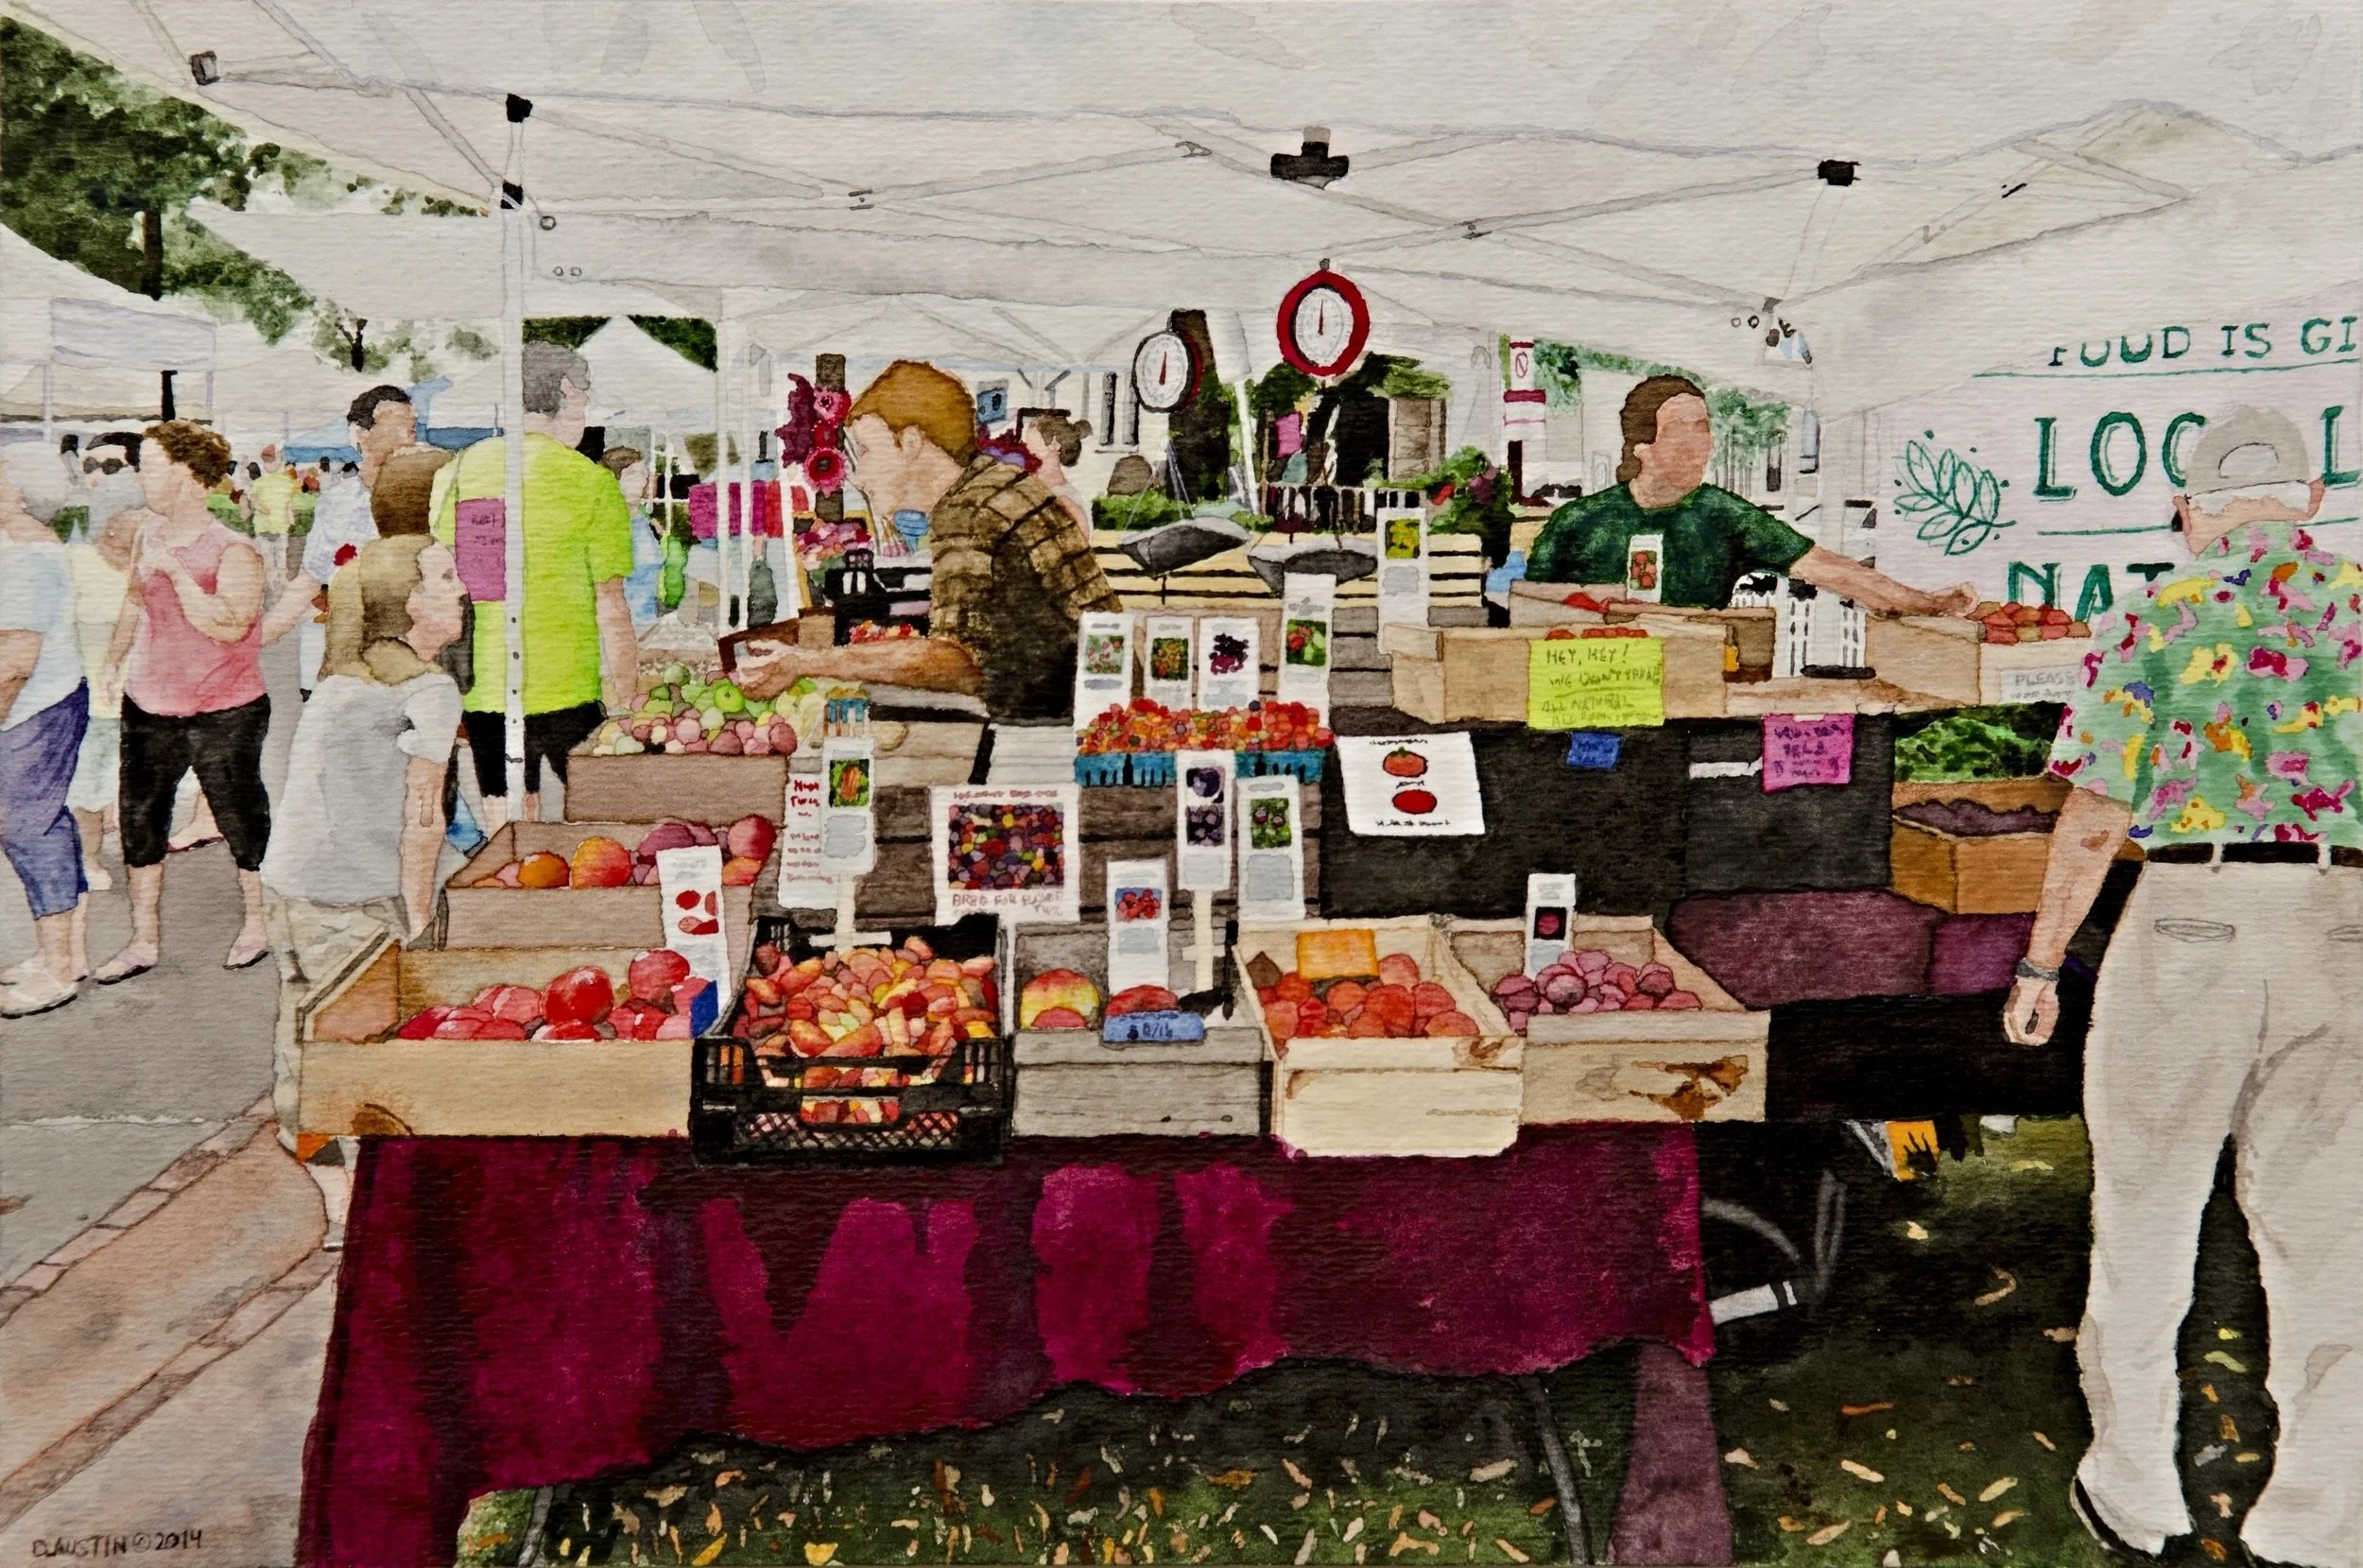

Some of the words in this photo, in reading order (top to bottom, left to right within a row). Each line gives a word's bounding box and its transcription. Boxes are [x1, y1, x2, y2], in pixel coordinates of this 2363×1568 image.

[2220, 322, 2272, 359] IS
[2032, 405, 2362, 504] LOCL
[1546, 648, 1582, 665] HEY,
[2014, 671, 2077, 687] PLEASE
